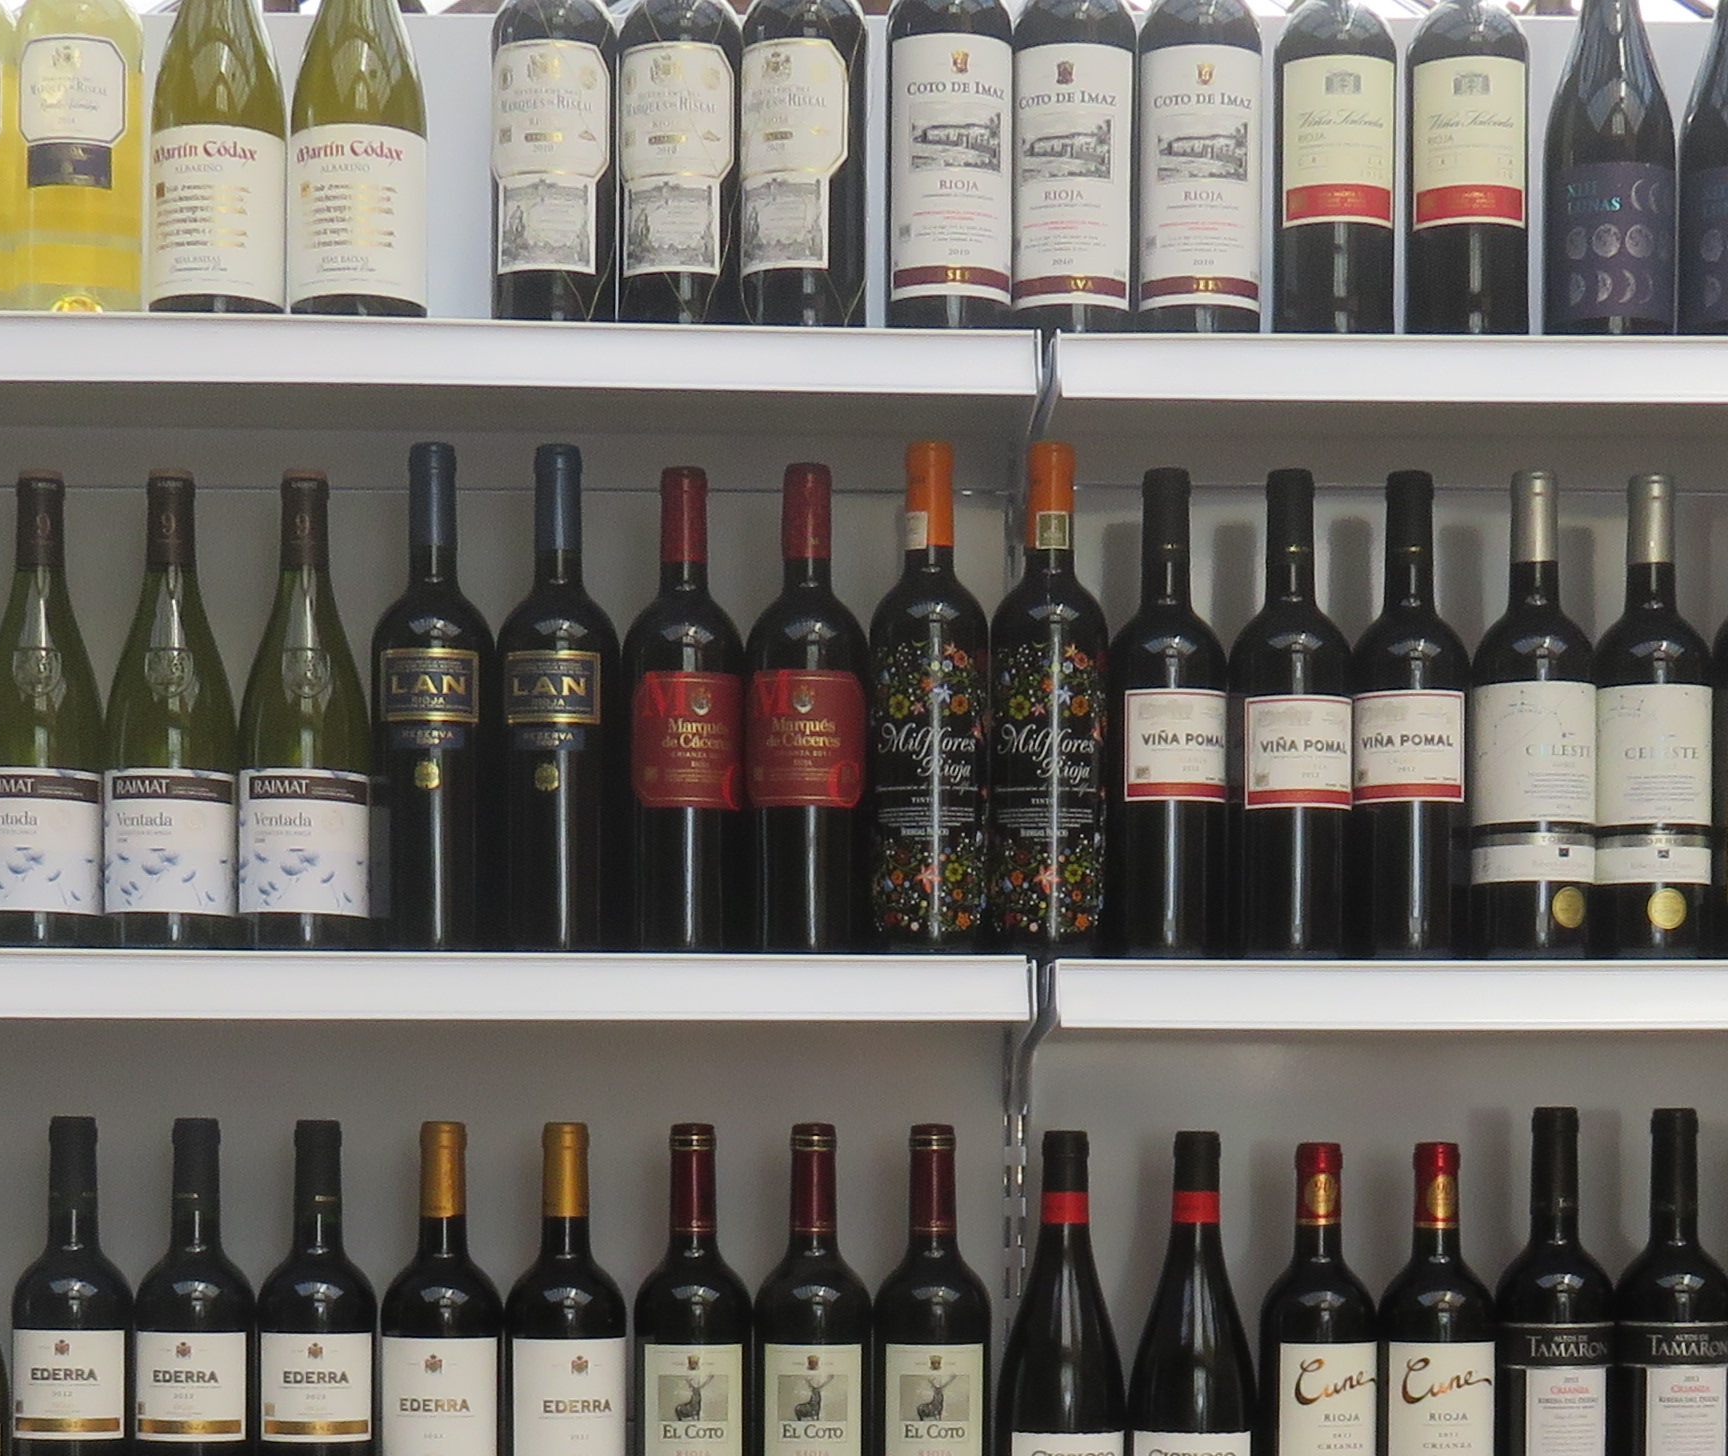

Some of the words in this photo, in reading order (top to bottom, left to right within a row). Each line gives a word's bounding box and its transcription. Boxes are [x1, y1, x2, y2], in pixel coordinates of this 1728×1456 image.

[907, 82, 946, 97] COTO
[951, 81, 970, 95] DE
[974, 82, 1006, 100] IMAZ
[1019, 93, 1052, 110] COTO
[1056, 91, 1075, 106] DE
[1079, 92, 1118, 108] IMAZ
[153, 141, 198, 163] Martín
[203, 138, 258, 163] Códax
[296, 141, 345, 163] Martín
[349, 138, 404, 163] Códax
[939, 178, 980, 193] RIOJA
[1043, 188, 1085, 202] RIOJA
[1183, 189, 1225, 203] RIOJA
[391, 674, 469, 697] LAN
[512, 676, 589, 698] LAN
[784, 732, 842, 750] Cáceres
[1141, 728, 1180, 747] VIÑA
[1185, 731, 1225, 750] POMAL
[1259, 735, 1299, 755] VIÑA
[1303, 739, 1348, 756] POMAL
[1360, 731, 1401, 750] VIÑA
[1404, 731, 1455, 749] POMAL
[916, 757, 972, 781] Rioja
[1035, 757, 1092, 781] Rioja
[116, 810, 173, 829] Ventada
[1525, 1335, 1609, 1359] TAMARON
[30, 1367, 98, 1383] EDERRA
[152, 1369, 219, 1385] EDERRA
[282, 1370, 350, 1385] EDERRA
[1294, 1358, 1377, 1406] Cune
[1400, 1358, 1492, 1405] Cune
[662, 1424, 680, 1440] EL
[684, 1424, 725, 1440] COTO
[781, 1424, 802, 1440] EL
[805, 1424, 844, 1440] COTO
[903, 1424, 924, 1440] EL
[927, 1424, 966, 1440] COTO
